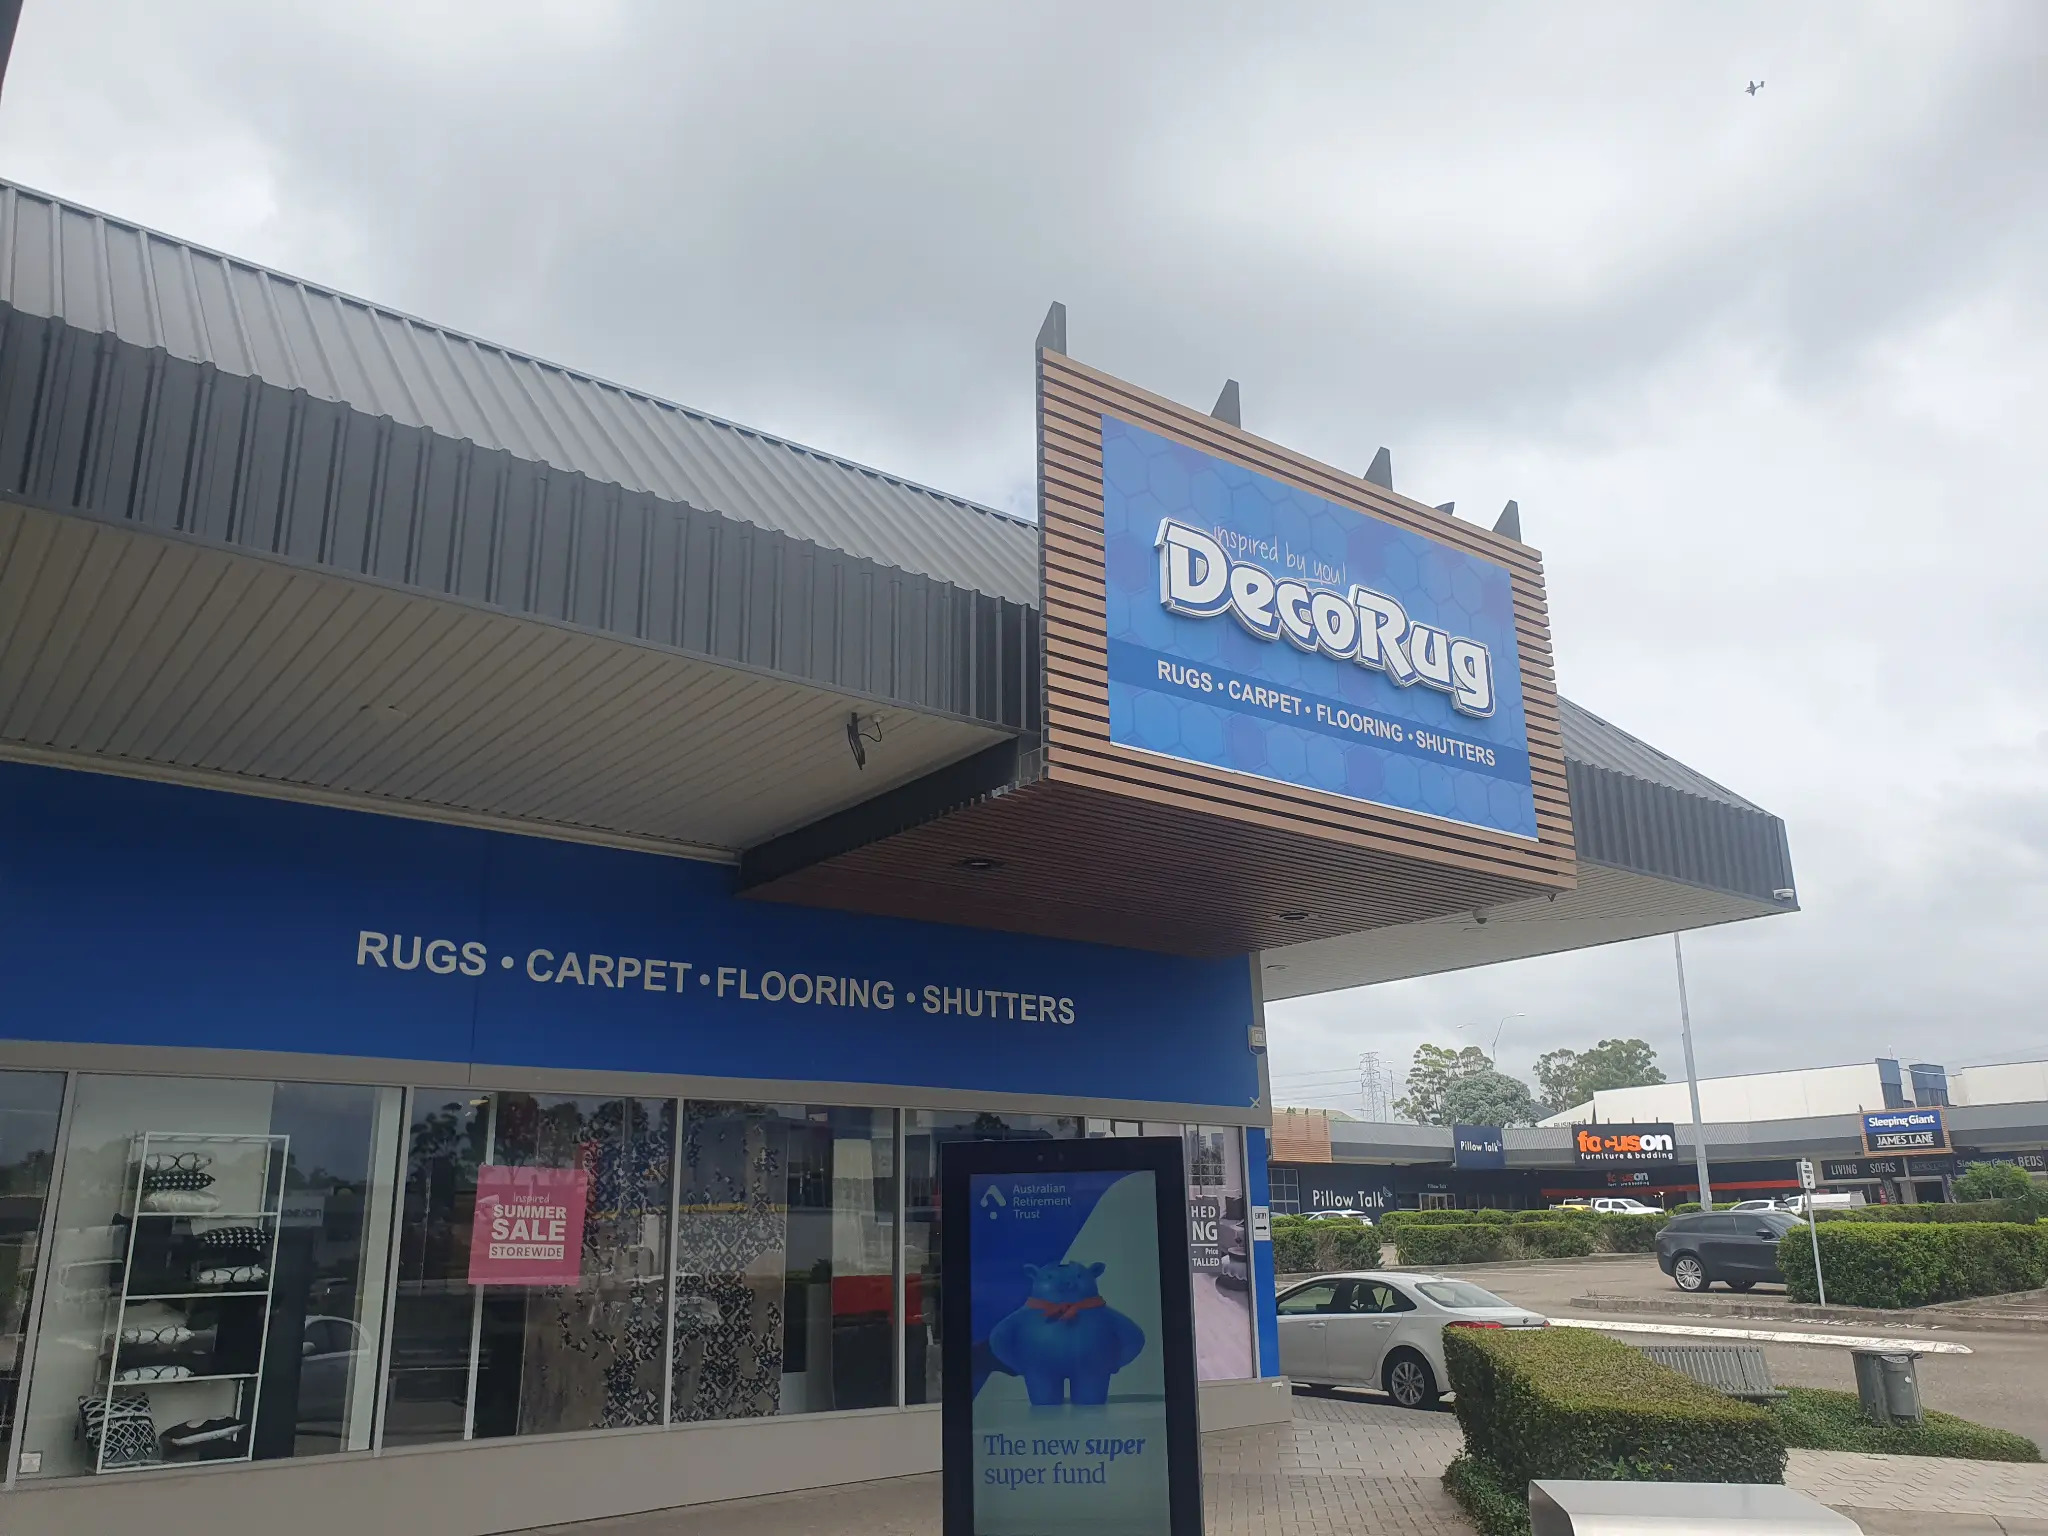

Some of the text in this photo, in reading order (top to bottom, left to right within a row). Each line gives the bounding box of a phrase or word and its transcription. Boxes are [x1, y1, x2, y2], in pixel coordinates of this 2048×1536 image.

[1285, 542, 1307, 578] by
[1313, 560, 1347, 585] you!
[1155, 518, 1495, 717] DecoRug
[1157, 659, 1496, 767] RUGS CARPET FLOORING SHUTTERS
[356, 930, 1075, 1025] RUGS CARPET FLOORING SHUTTERS
[1868, 1114, 1935, 1128] Sleeping Giant
[1460, 1140, 1498, 1152] Pillow Talk
[1877, 1134, 1934, 1146] JAMES LANE
[1581, 1152, 1624, 1160] furniture
[1635, 1151, 1673, 1160] bedding
[2017, 1155, 2043, 1167] BEDS
[1830, 1163, 1858, 1175] LIVING
[1869, 1162, 1896, 1174] SOFAS
[1013, 1183, 1066, 1194] Australian
[513, 1191, 550, 1204] Inspired
[1013, 1196, 1072, 1207] Retirement
[1312, 1189, 1384, 1208] Pillow Talk
[493, 1204, 567, 1219] SUMMER
[1014, 1209, 1041, 1219] Trust
[491, 1219, 566, 1241] SALE
[491, 1245, 562, 1258] STOREWIDE
[1205, 1247, 1219, 1255] Price
[983, 1433, 1146, 1462] The new super
[984, 1461, 1106, 1491] super fund
